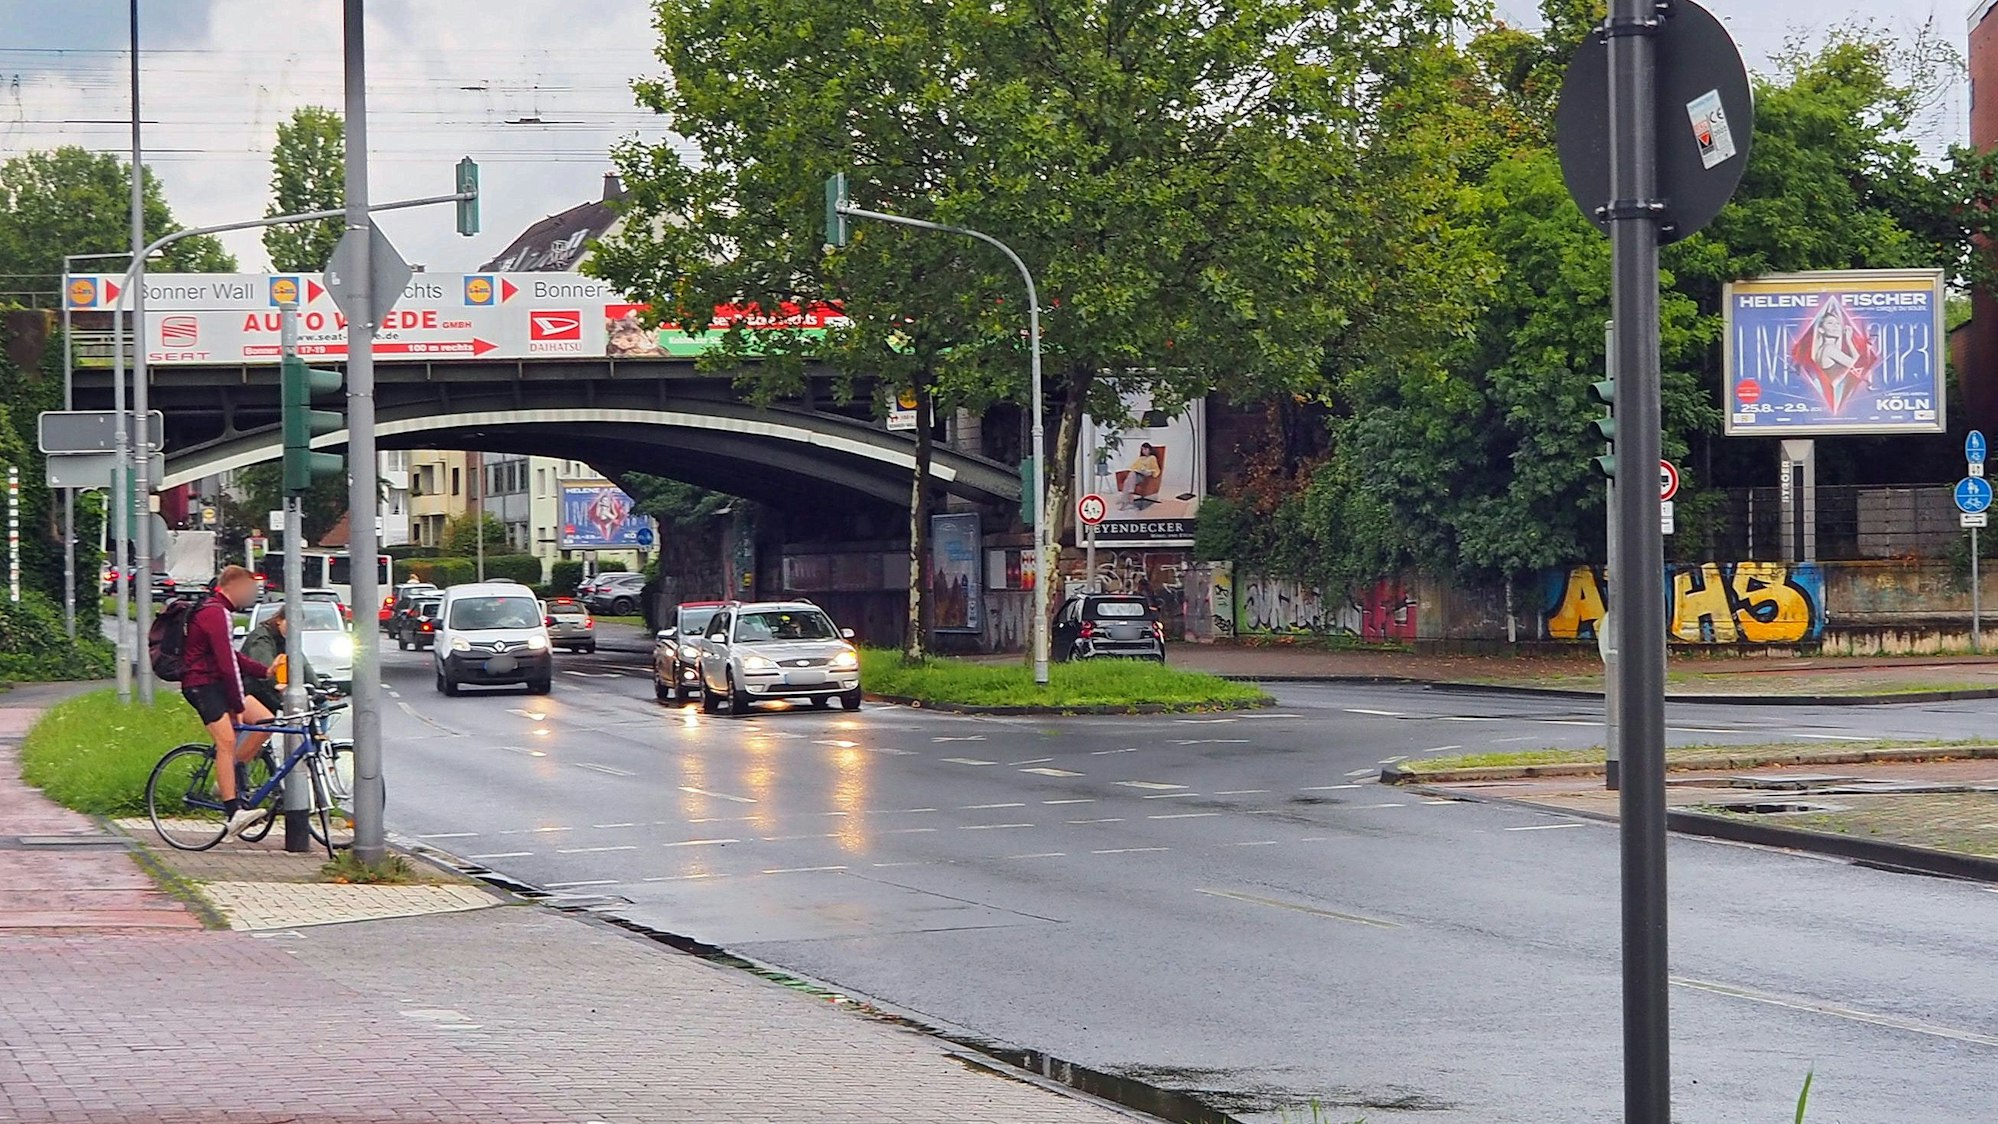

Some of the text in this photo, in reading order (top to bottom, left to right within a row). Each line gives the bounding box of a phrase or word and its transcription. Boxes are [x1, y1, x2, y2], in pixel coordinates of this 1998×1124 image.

[212, 283, 255, 299] Wall
[403, 283, 442, 299] chts
[535, 282, 603, 298] Bonner
[1740, 293, 1927, 308] HELENE FISCHER
[243, 312, 325, 332] AUO
[408, 344, 427, 352] 100
[530, 342, 582, 352] DAIHATSU
[149, 352, 211, 361] SEAT
[1876, 396, 1930, 411] KÖLN
